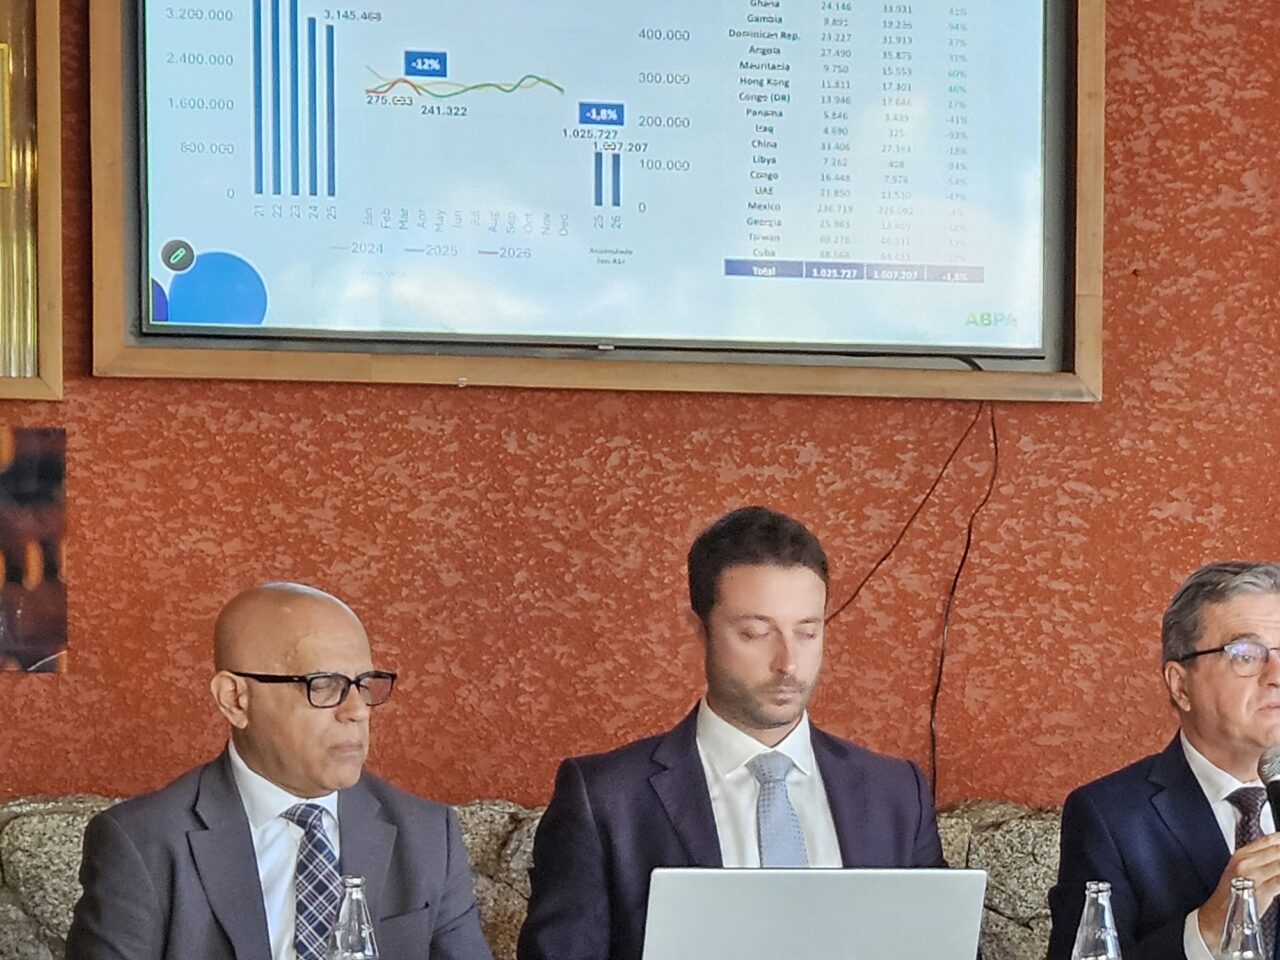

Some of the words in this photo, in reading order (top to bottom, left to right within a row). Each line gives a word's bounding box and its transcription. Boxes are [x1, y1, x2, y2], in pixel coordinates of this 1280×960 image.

[165, 7, 234, 22] 3.200.000
[746, 13, 783, 24] Gambia
[638, 28, 690, 41] 400.000
[166, 52, 234, 66] 2.400.000
[411, 58, 441, 71] -12%
[638, 72, 690, 85] 300.000
[168, 97, 235, 111] 1.600.000
[746, 108, 784, 118] Panama
[637, 115, 691, 129] 200.000
[180, 141, 235, 155] 800.000
[751, 139, 778, 149] China
[639, 158, 690, 172] 100.000
[752, 155, 777, 165] Libya
[749, 170, 779, 182] Congo
[227, 187, 236, 199] 0
[254, 205, 265, 217] 21
[272, 205, 283, 218] 22
[290, 205, 301, 219] 23
[637, 201, 647, 214] 0
[747, 201, 781, 211] Mexico
[308, 206, 319, 220] 24
[326, 206, 338, 220] 25
[380, 208, 391, 229] Feb
[434, 210, 446, 232] May
[541, 213, 551, 236] Nov
[351, 243, 384, 254] 2024
[753, 249, 776, 258] Cuba
[752, 265, 776, 276] Total
